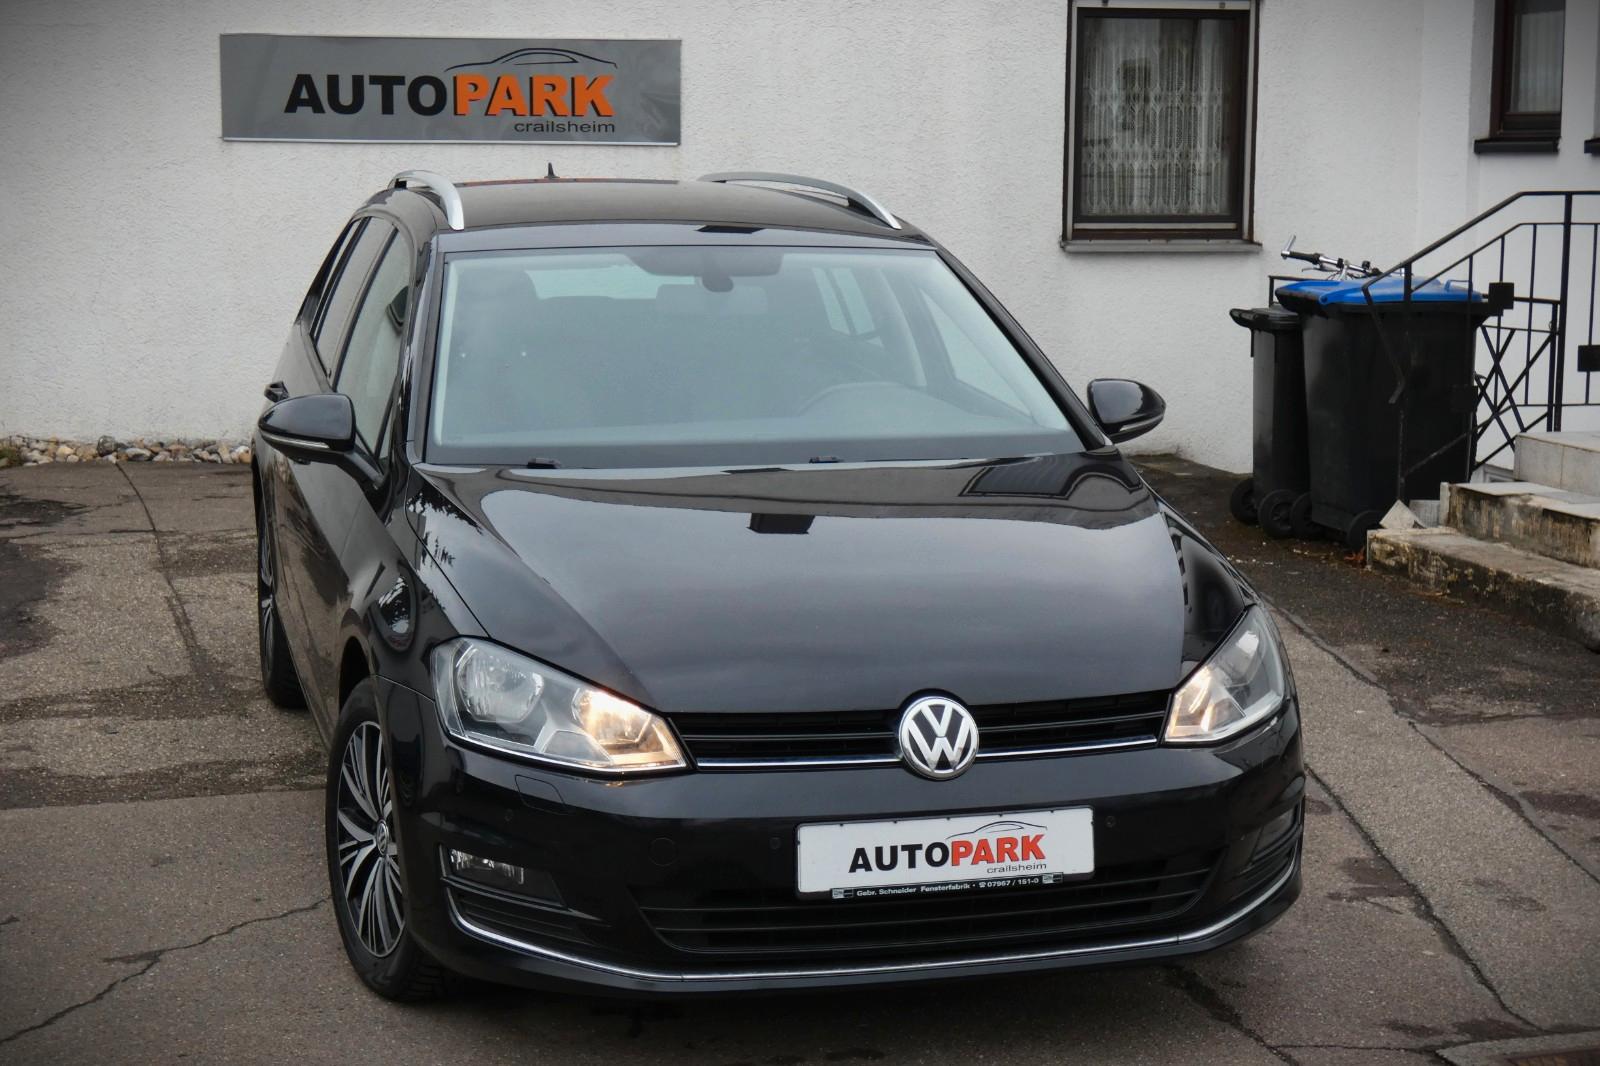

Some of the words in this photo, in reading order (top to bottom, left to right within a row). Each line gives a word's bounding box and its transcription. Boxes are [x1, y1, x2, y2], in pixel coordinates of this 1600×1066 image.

[284, 73, 615, 117] AUTOPARK
[514, 120, 615, 134] crailsheim
[902, 698, 977, 776] VW
[848, 834, 1045, 873] AUTOPARK
[986, 863, 1047, 874] crailsheim
[856, 889, 877, 897] Gebr.
[879, 887, 917, 896] Schneider
[920, 883, 970, 893] Fensterfabrik
